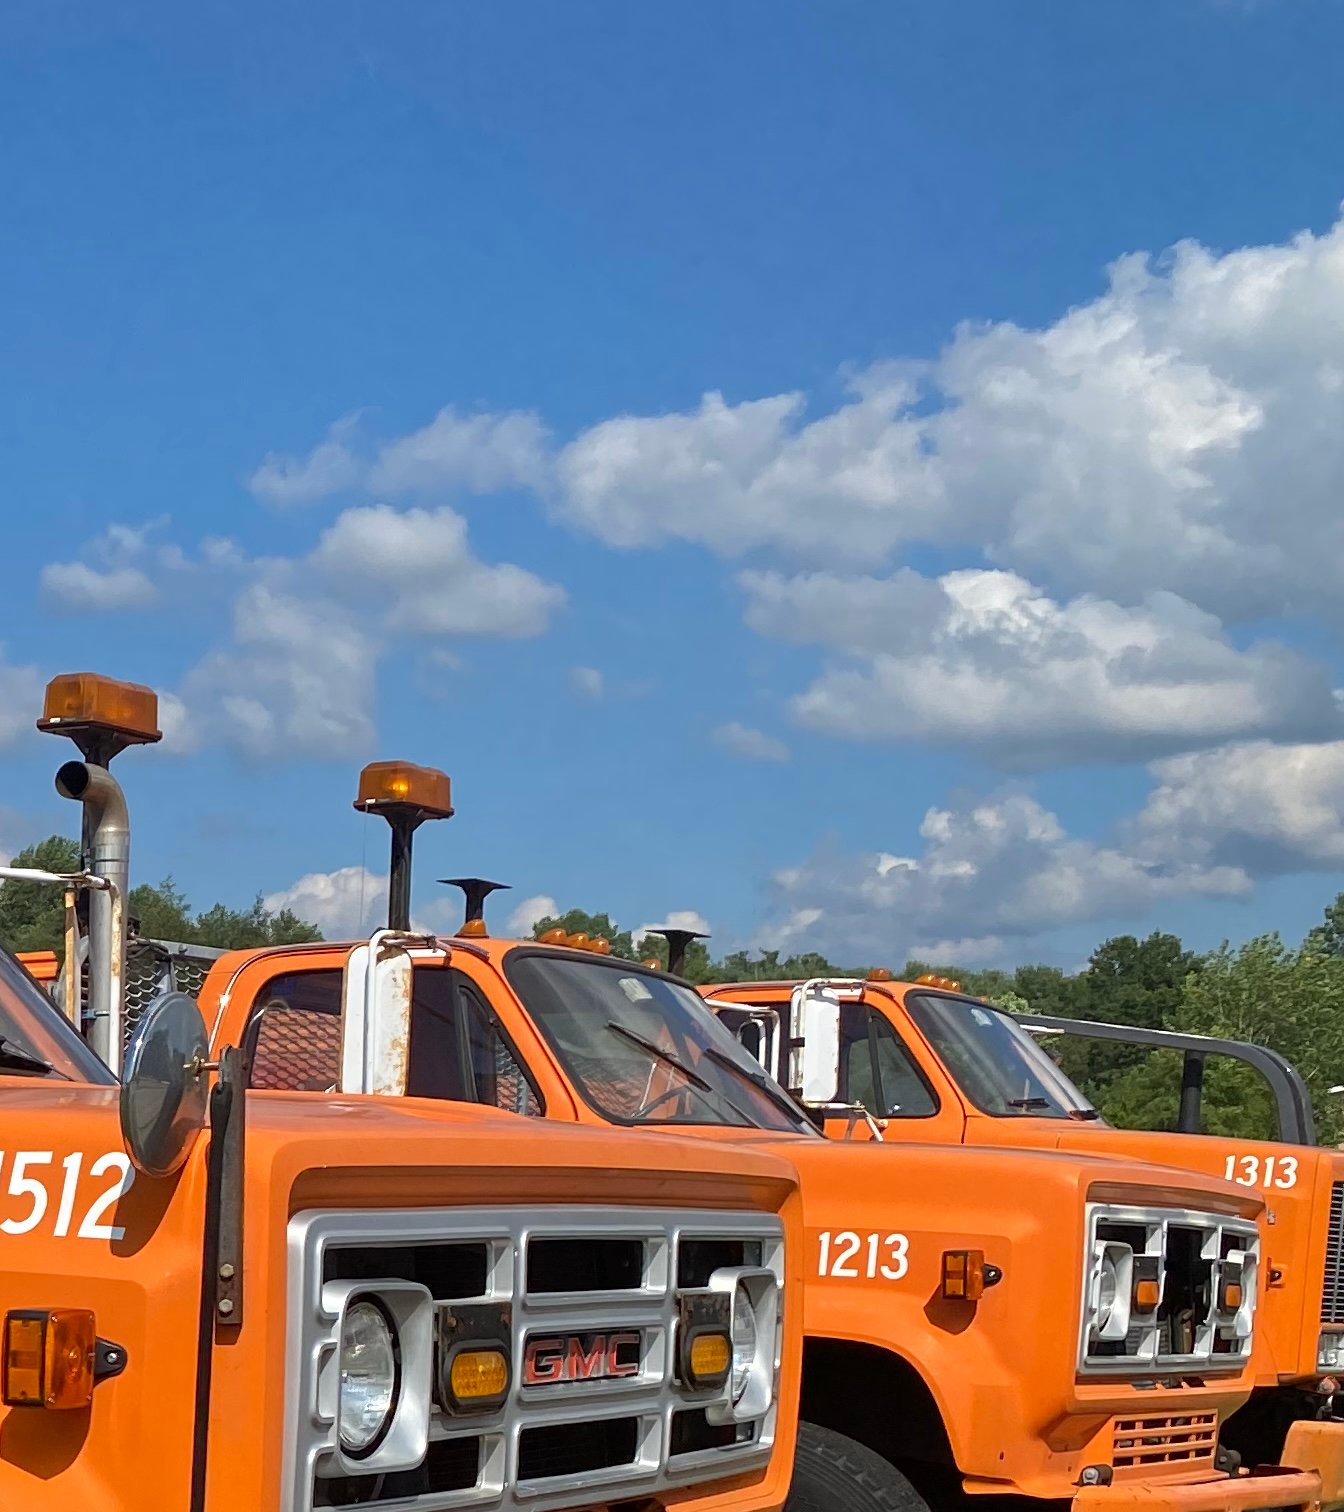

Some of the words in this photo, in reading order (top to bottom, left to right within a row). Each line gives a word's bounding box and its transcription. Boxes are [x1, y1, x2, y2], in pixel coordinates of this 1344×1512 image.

[1224, 1155, 1298, 1188] 1313
[818, 1231, 909, 1280] 1213
[524, 1333, 640, 1383] GMC
